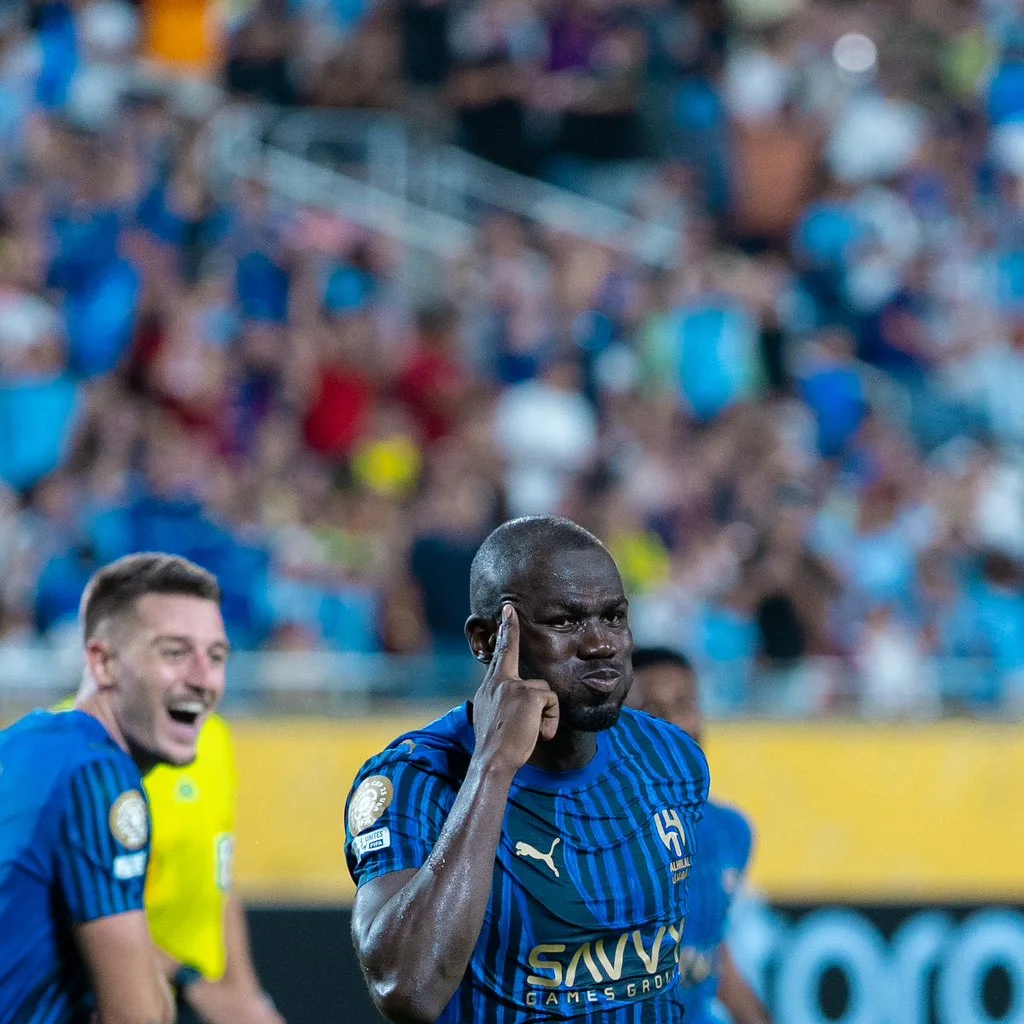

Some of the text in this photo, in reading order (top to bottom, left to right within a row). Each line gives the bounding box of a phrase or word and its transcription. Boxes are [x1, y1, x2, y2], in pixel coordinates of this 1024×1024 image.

[526, 917, 686, 988] SAVVY
[526, 971, 676, 1006] GAMES GROU
